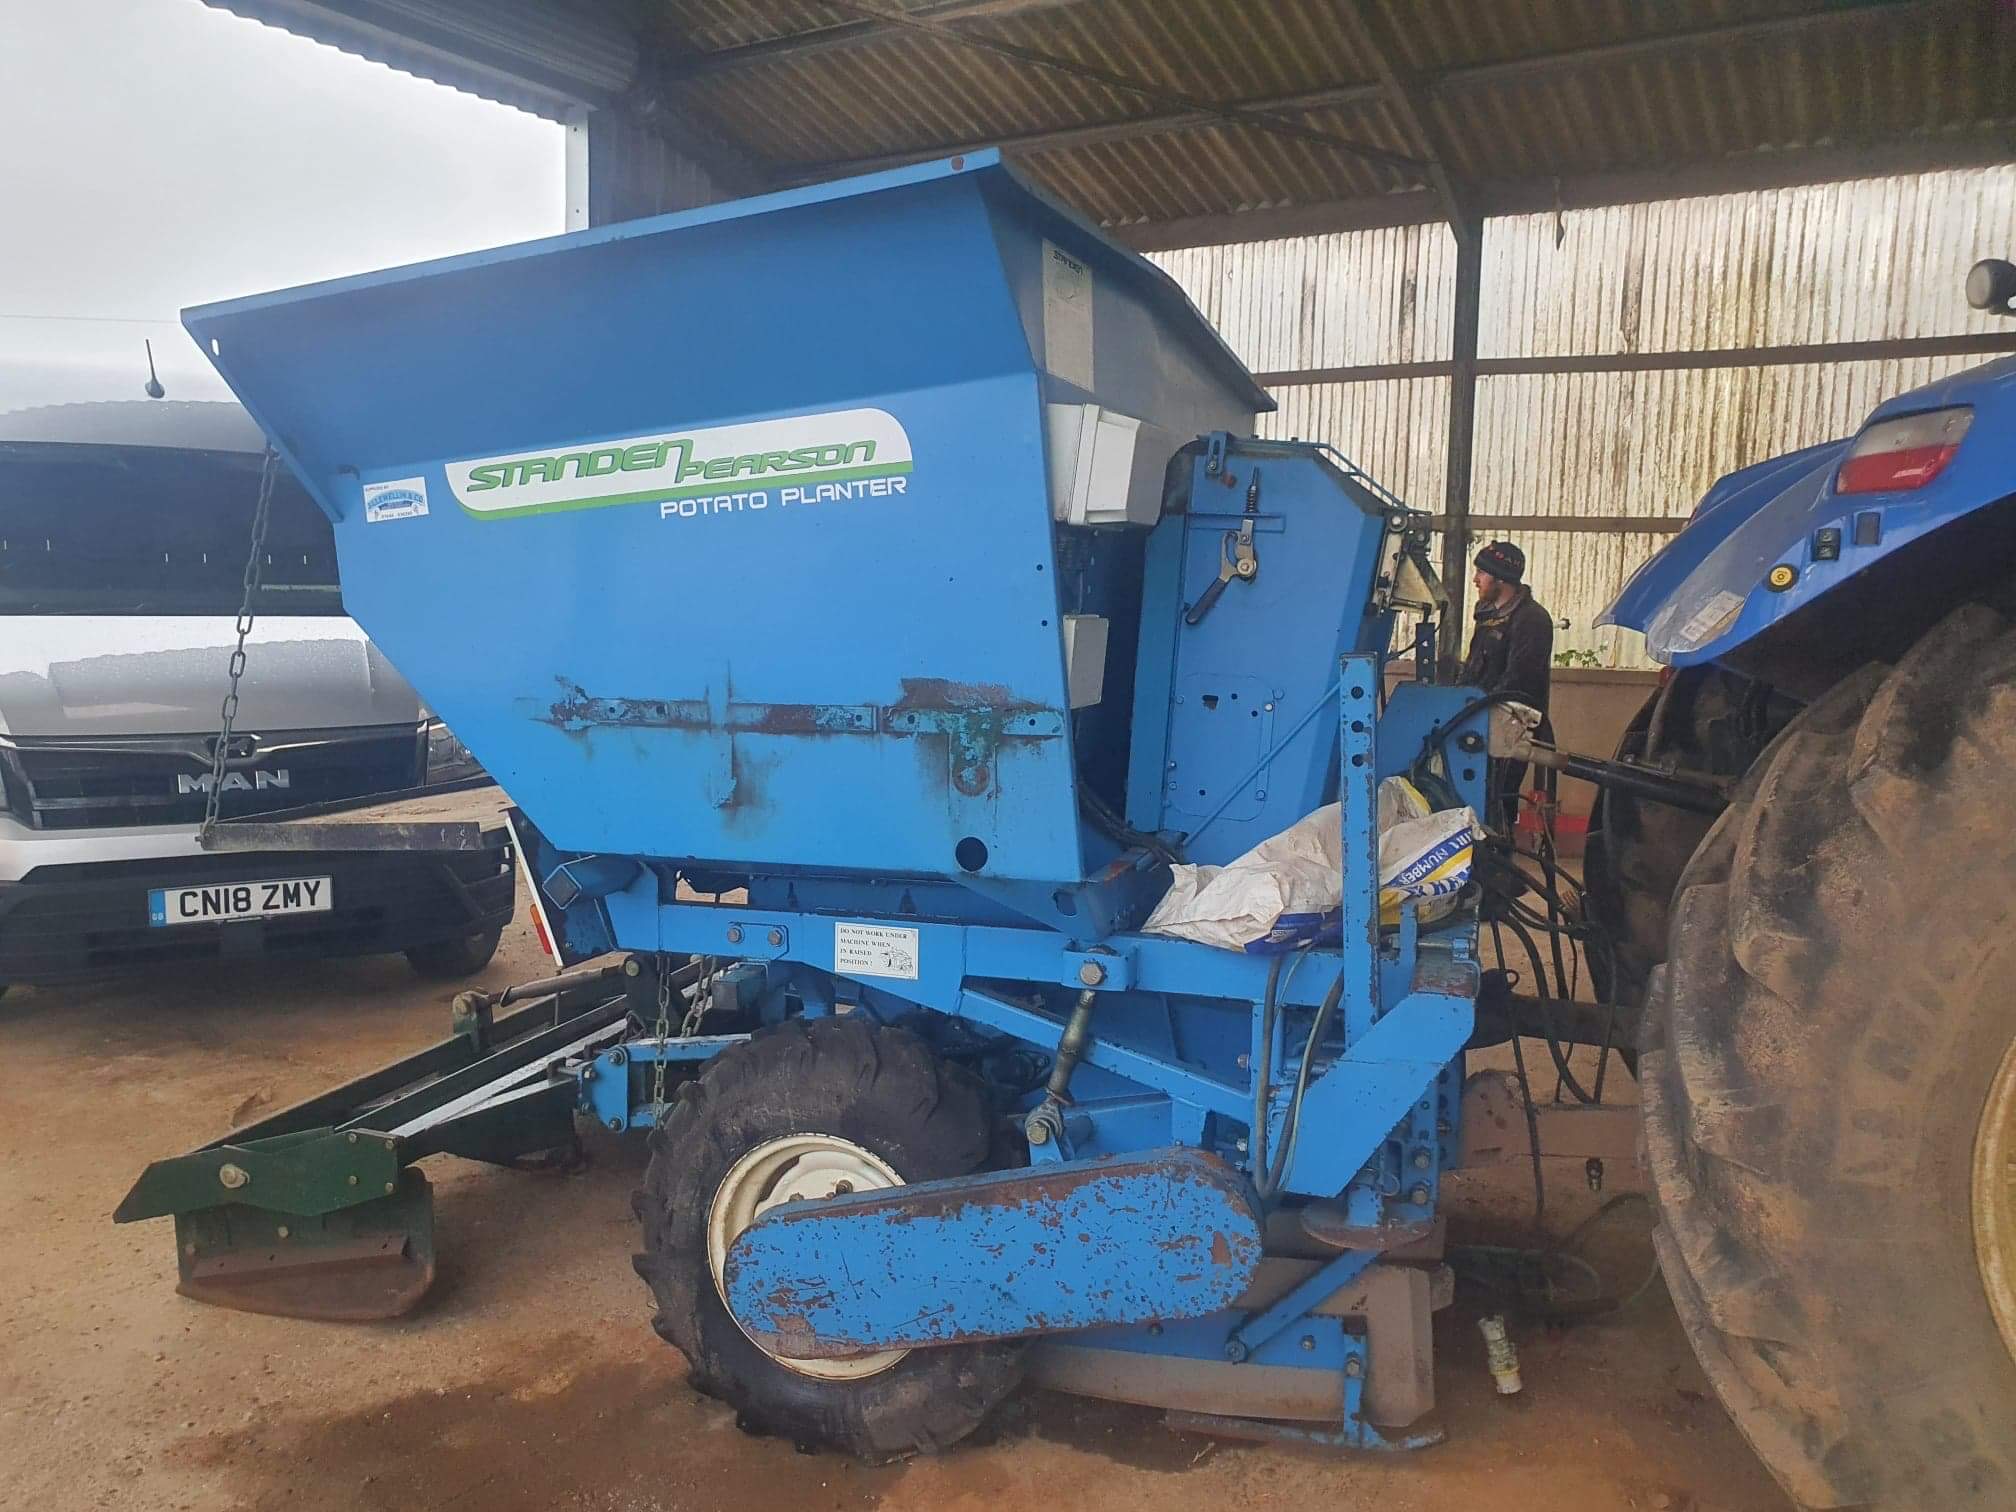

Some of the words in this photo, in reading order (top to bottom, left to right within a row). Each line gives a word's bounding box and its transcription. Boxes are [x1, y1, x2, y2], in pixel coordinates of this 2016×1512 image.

[467, 439, 694, 492] STANDEN
[674, 440, 876, 483] PEARSON
[660, 491, 768, 520] POTATO
[781, 476, 907, 507] PLANTER
[178, 769, 290, 793] MAN
[1399, 847, 1449, 885] NUMBER
[179, 886, 251, 917] CN18
[261, 880, 321, 910] ZMY
[840, 938, 869, 946] MACHINE
[885, 931, 907, 939] UNDER
